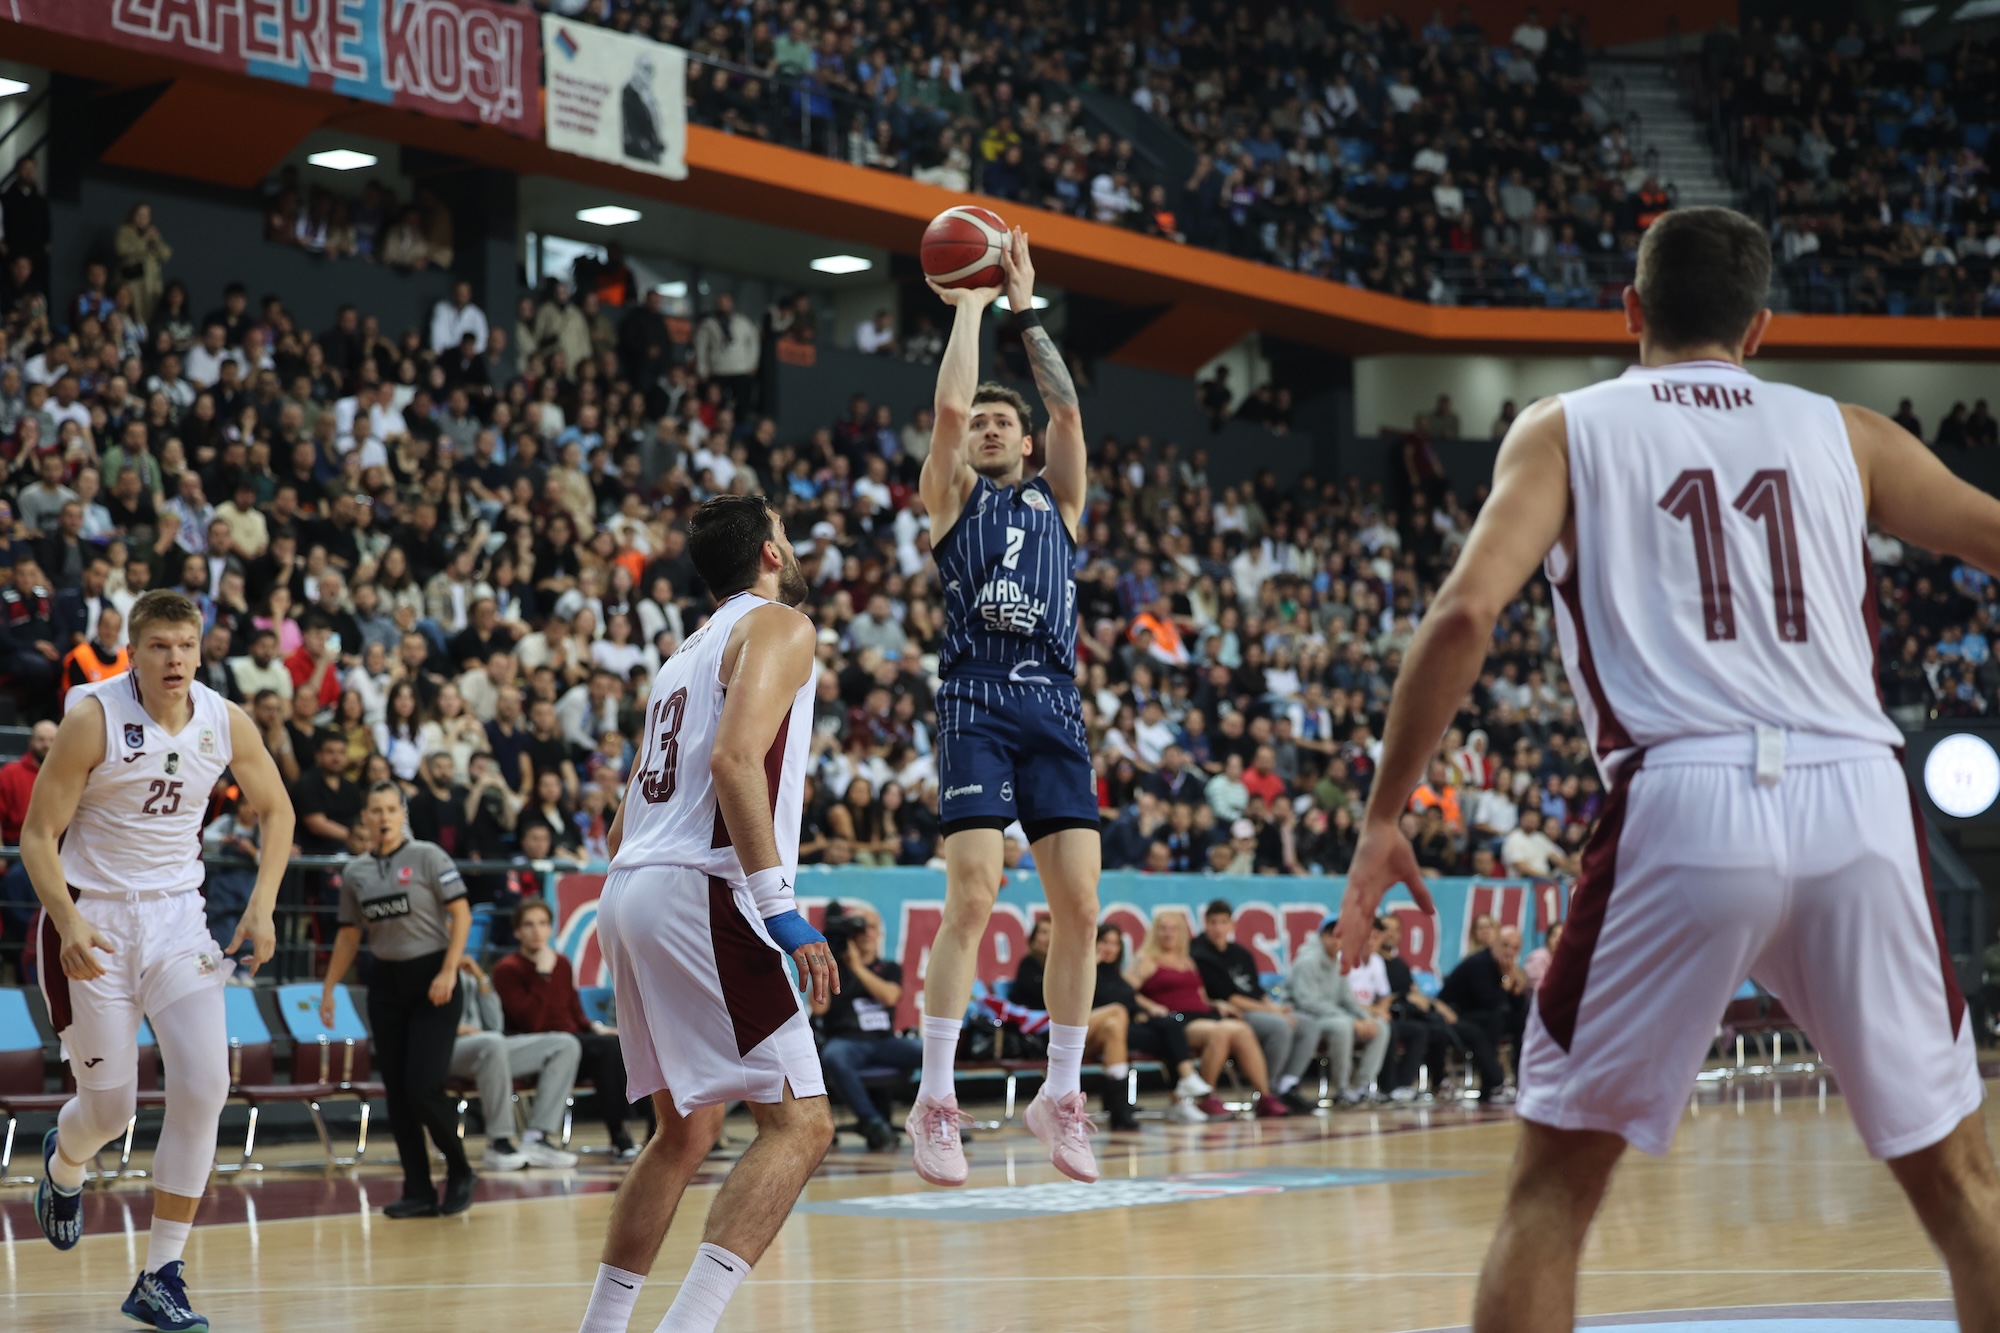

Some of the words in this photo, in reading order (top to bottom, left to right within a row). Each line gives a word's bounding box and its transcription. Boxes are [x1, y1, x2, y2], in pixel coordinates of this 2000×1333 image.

[377, 0, 524, 124] KOŞ!
[1002, 526, 1026, 570] 2
[1657, 468, 1809, 643] 11
[980, 603, 1038, 629] EFES
[638, 686, 688, 805] 13
[142, 780, 184, 815] 25
